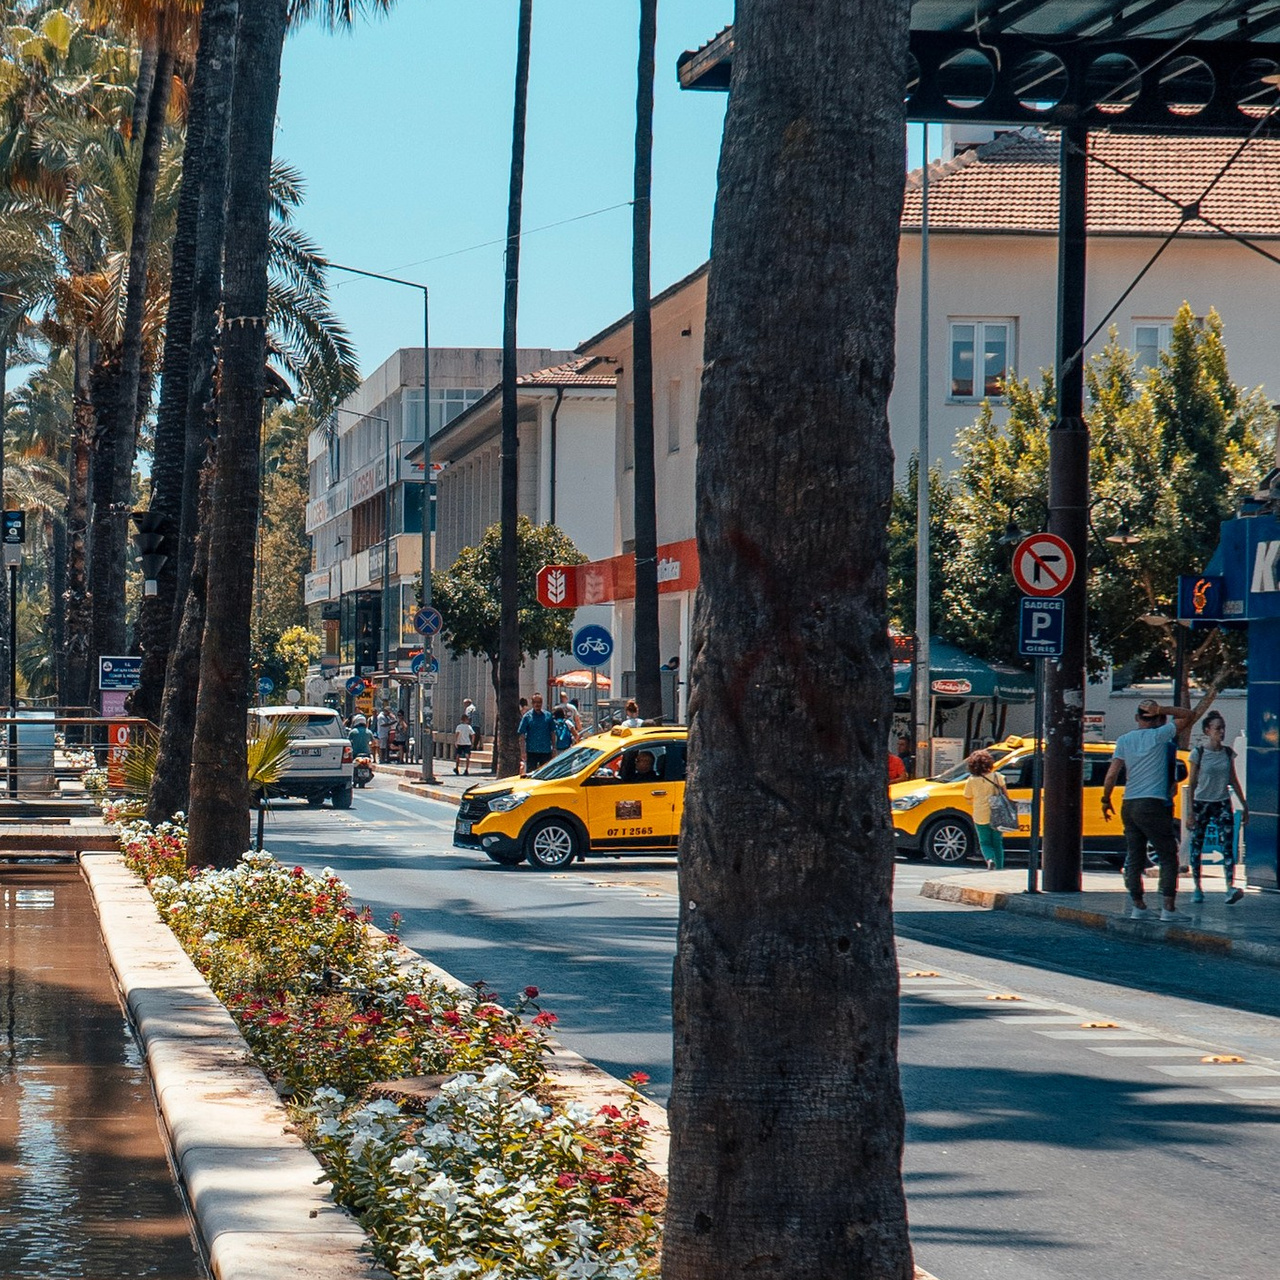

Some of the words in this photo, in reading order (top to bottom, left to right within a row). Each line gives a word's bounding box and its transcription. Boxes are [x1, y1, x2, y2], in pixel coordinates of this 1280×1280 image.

[1024, 601, 1062, 610] SADECE
[1031, 611, 1052, 638] P
[607, 828, 619, 837] 07
[629, 826, 654, 836] 2565
